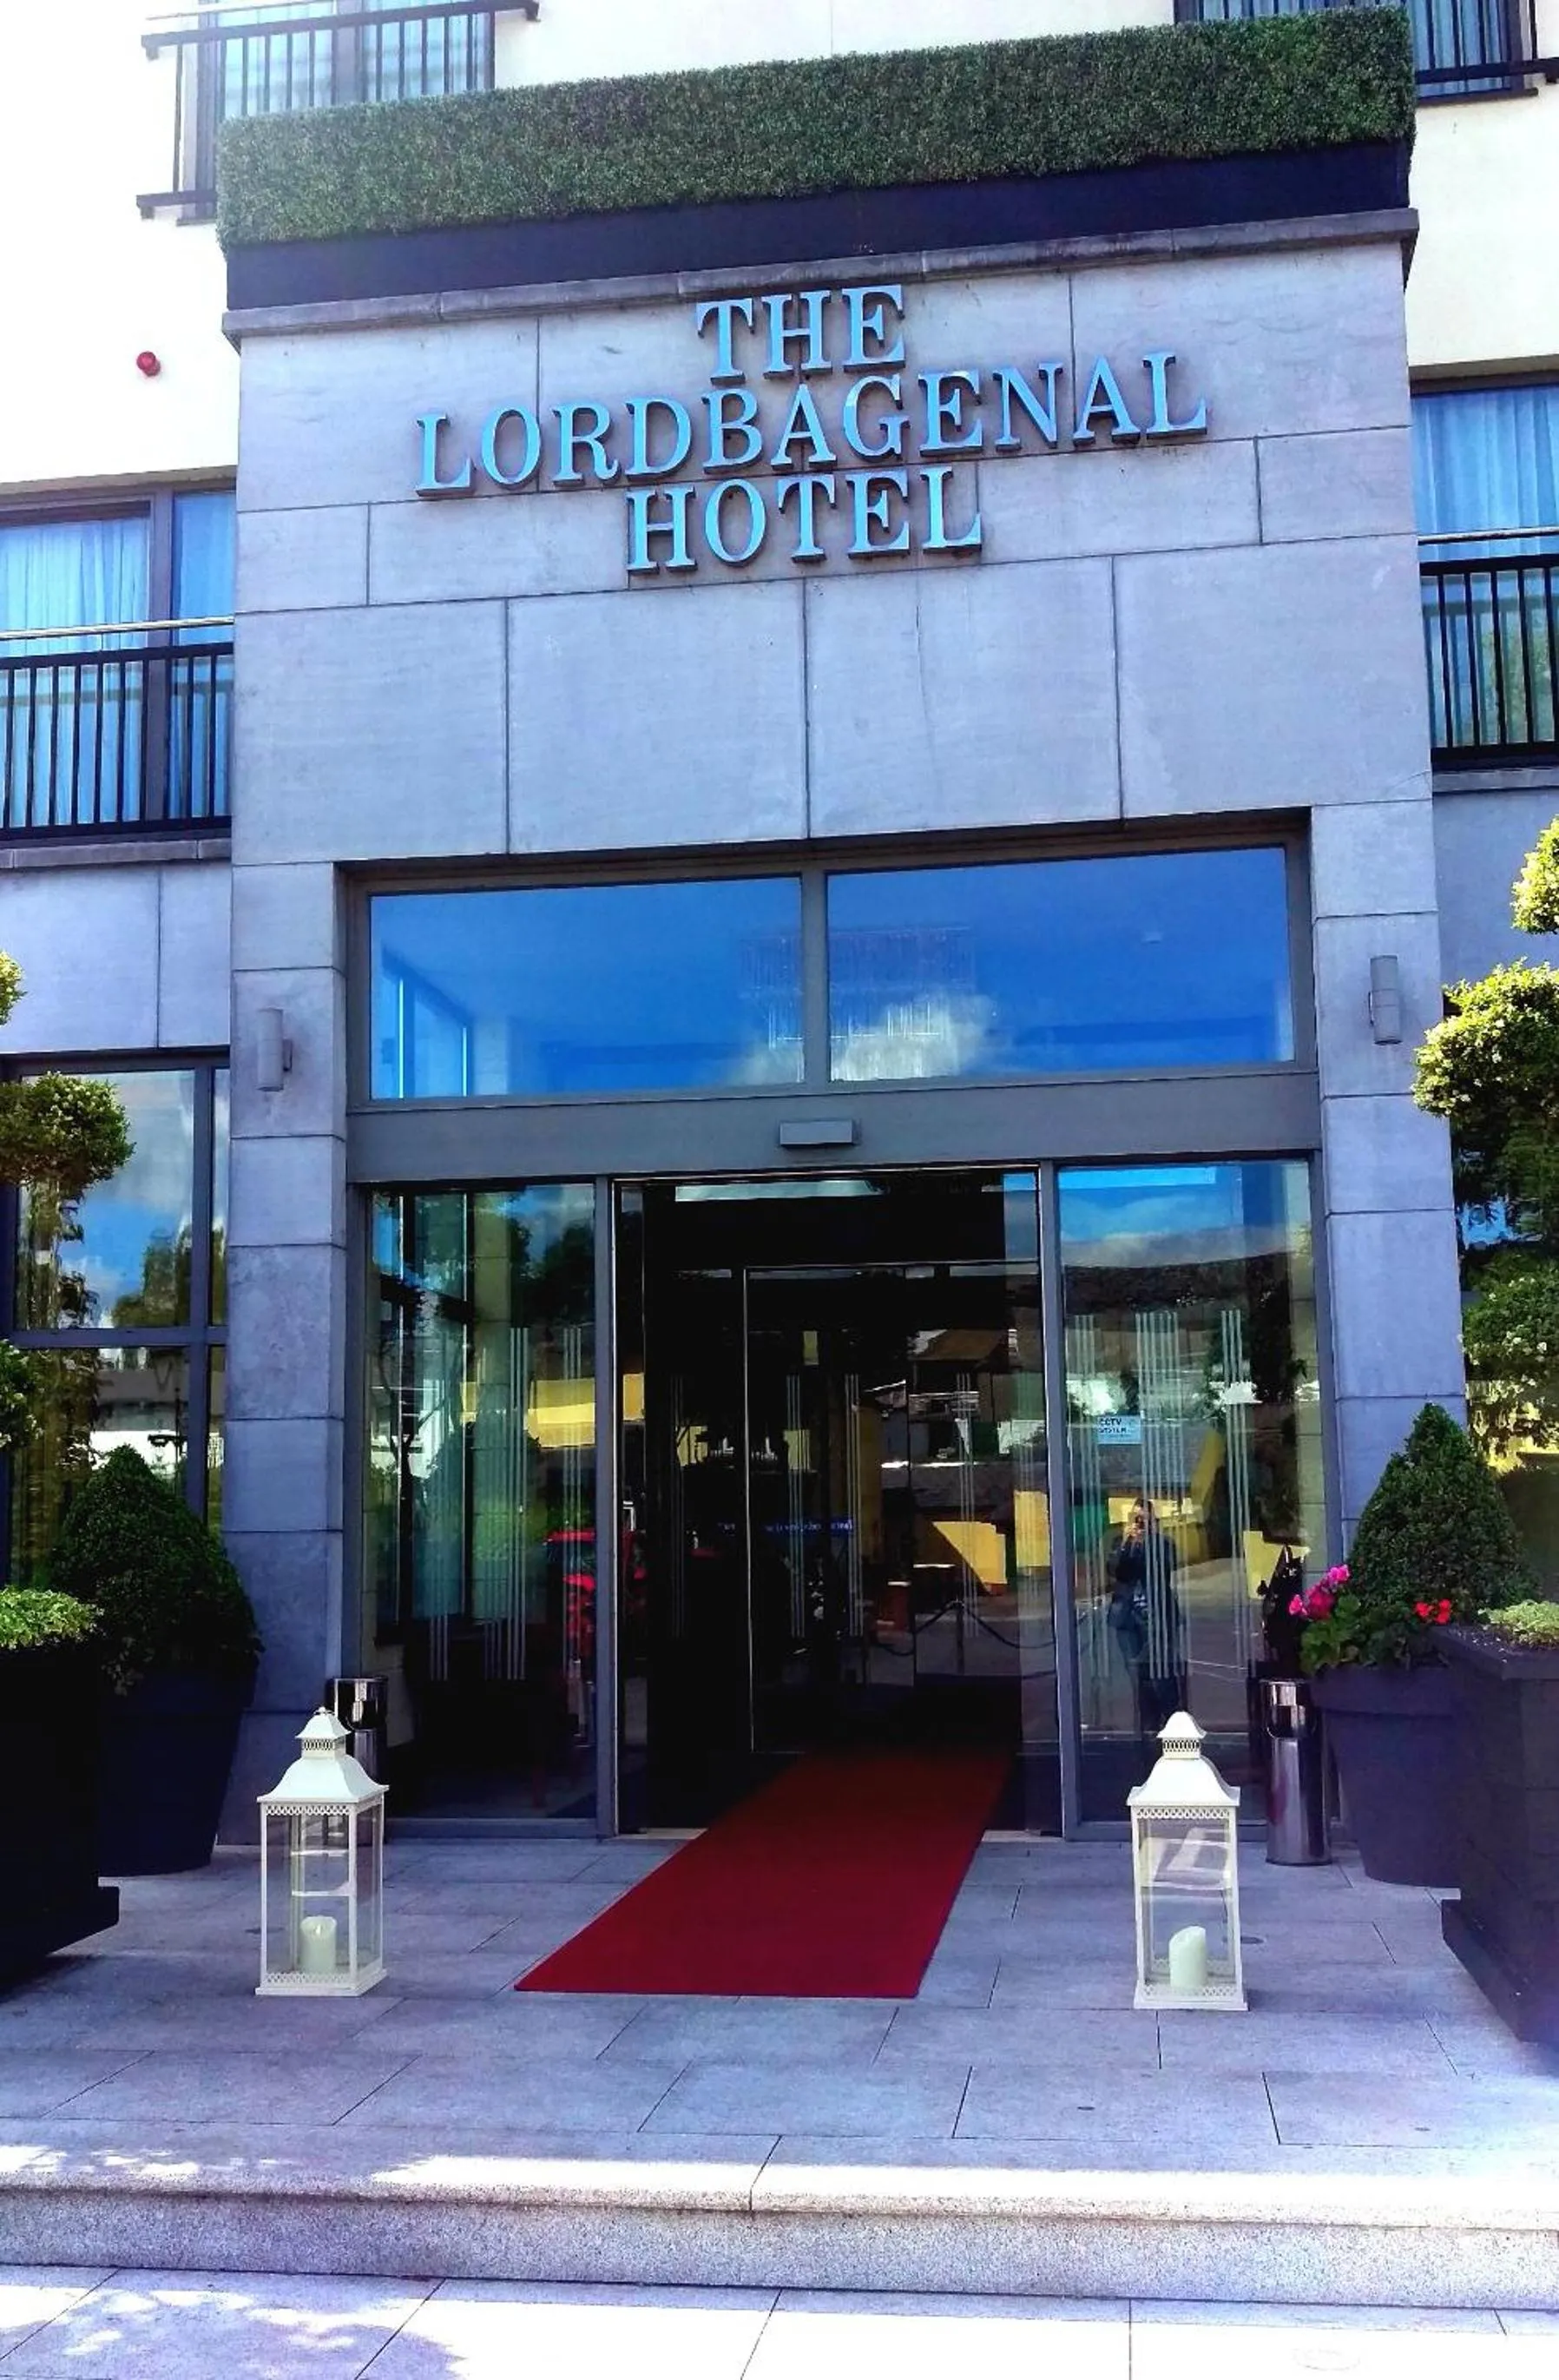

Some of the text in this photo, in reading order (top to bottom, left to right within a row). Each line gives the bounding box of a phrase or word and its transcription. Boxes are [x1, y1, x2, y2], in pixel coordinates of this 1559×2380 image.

[697, 285, 905, 386] THE
[626, 465, 981, 573] HOTEL
[1099, 1417, 1122, 1426] CCTV
